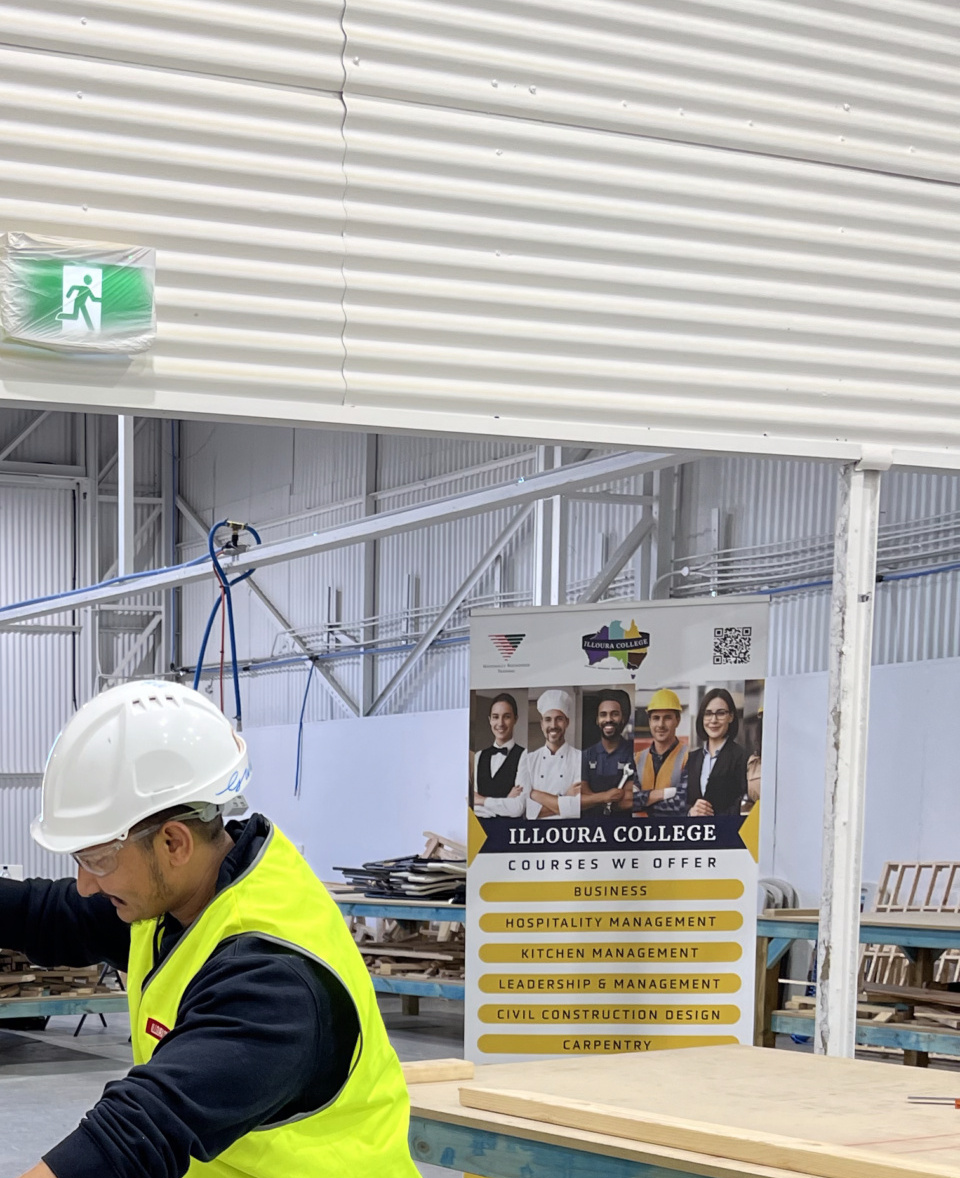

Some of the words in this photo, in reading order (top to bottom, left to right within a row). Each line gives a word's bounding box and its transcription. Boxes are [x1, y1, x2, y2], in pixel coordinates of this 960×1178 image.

[583, 640, 615, 650] ILLOURA
[616, 638, 649, 649] COLLEGE
[509, 827, 606, 845] ILLOURA
[613, 824, 717, 843] COLLEGE
[508, 859, 599, 871] COURSES
[612, 858, 640, 869] WE
[653, 857, 717, 869] OFFER
[574, 885, 648, 897] BUSINESS
[505, 917, 602, 928] HOSPITALITY
[609, 916, 717, 927] MANAGEMENT
[521, 948, 585, 959] KITCHEN
[592, 947, 699, 958] MANAGEMENT
[498, 979, 591, 990] LEADERSHIP
[598, 978, 606, 989] &
[614, 978, 720, 989] MANAGEMENT
[497, 1009, 535, 1020] CIVIL
[541, 1009, 658, 1020] CONSTRUCTION
[666, 1009, 721, 1020] DESIGN
[563, 1039, 652, 1051] CARPENTRY
